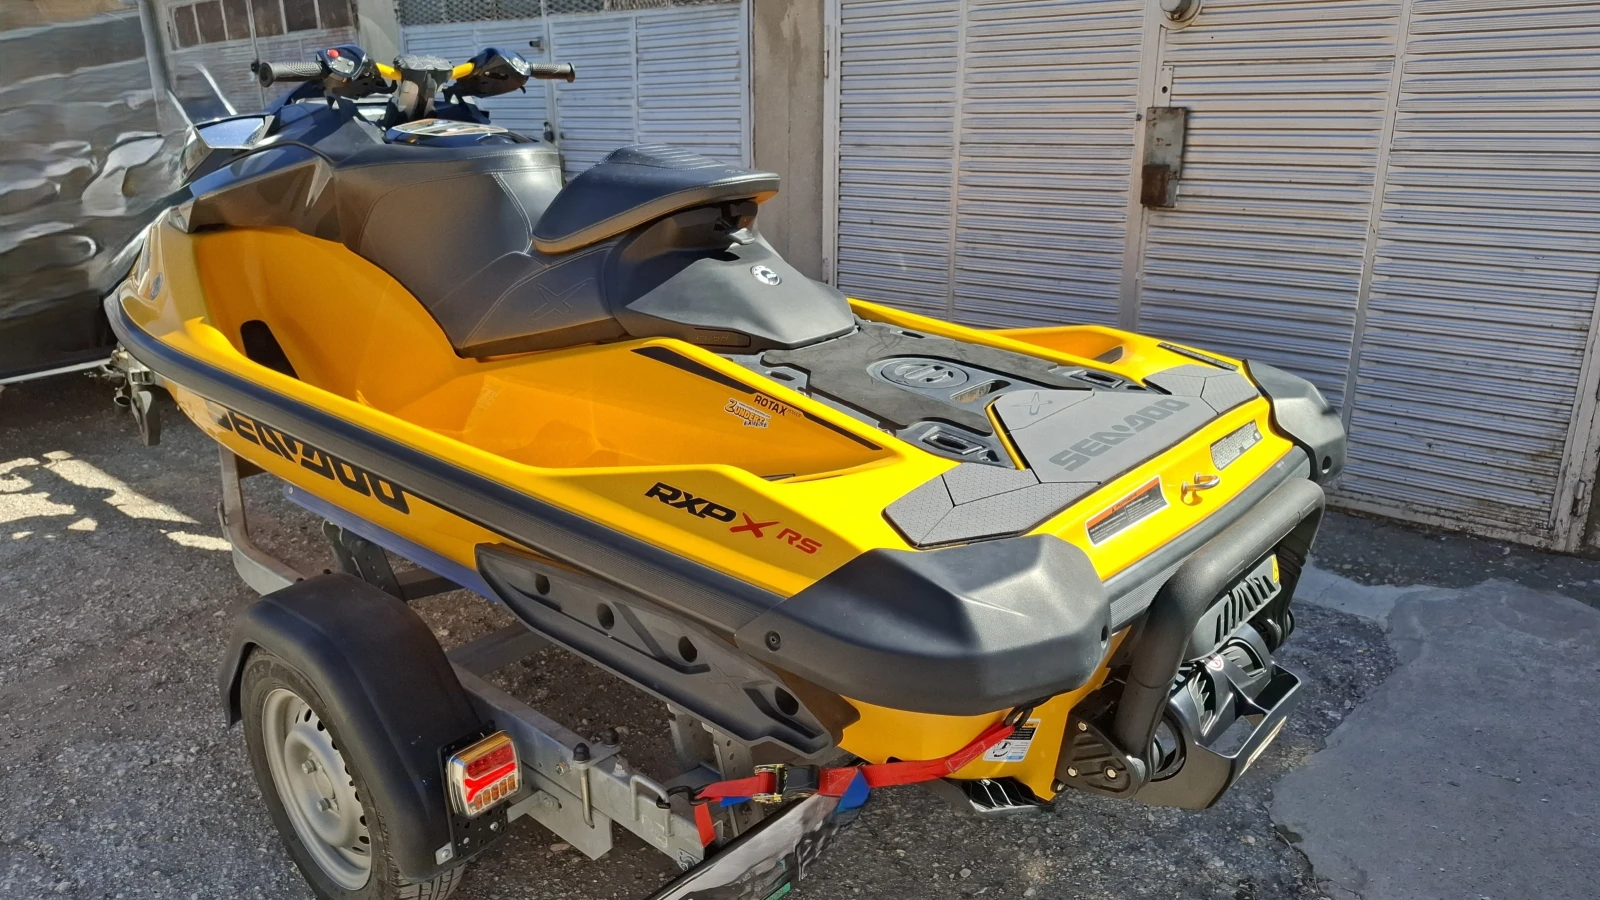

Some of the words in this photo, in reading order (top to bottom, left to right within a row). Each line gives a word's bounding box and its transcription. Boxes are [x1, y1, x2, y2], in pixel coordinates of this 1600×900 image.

[754, 395, 787, 416] ROTAX
[644, 482, 737, 523] RXP
[729, 512, 780, 538] X
[776, 528, 823, 555] RS
